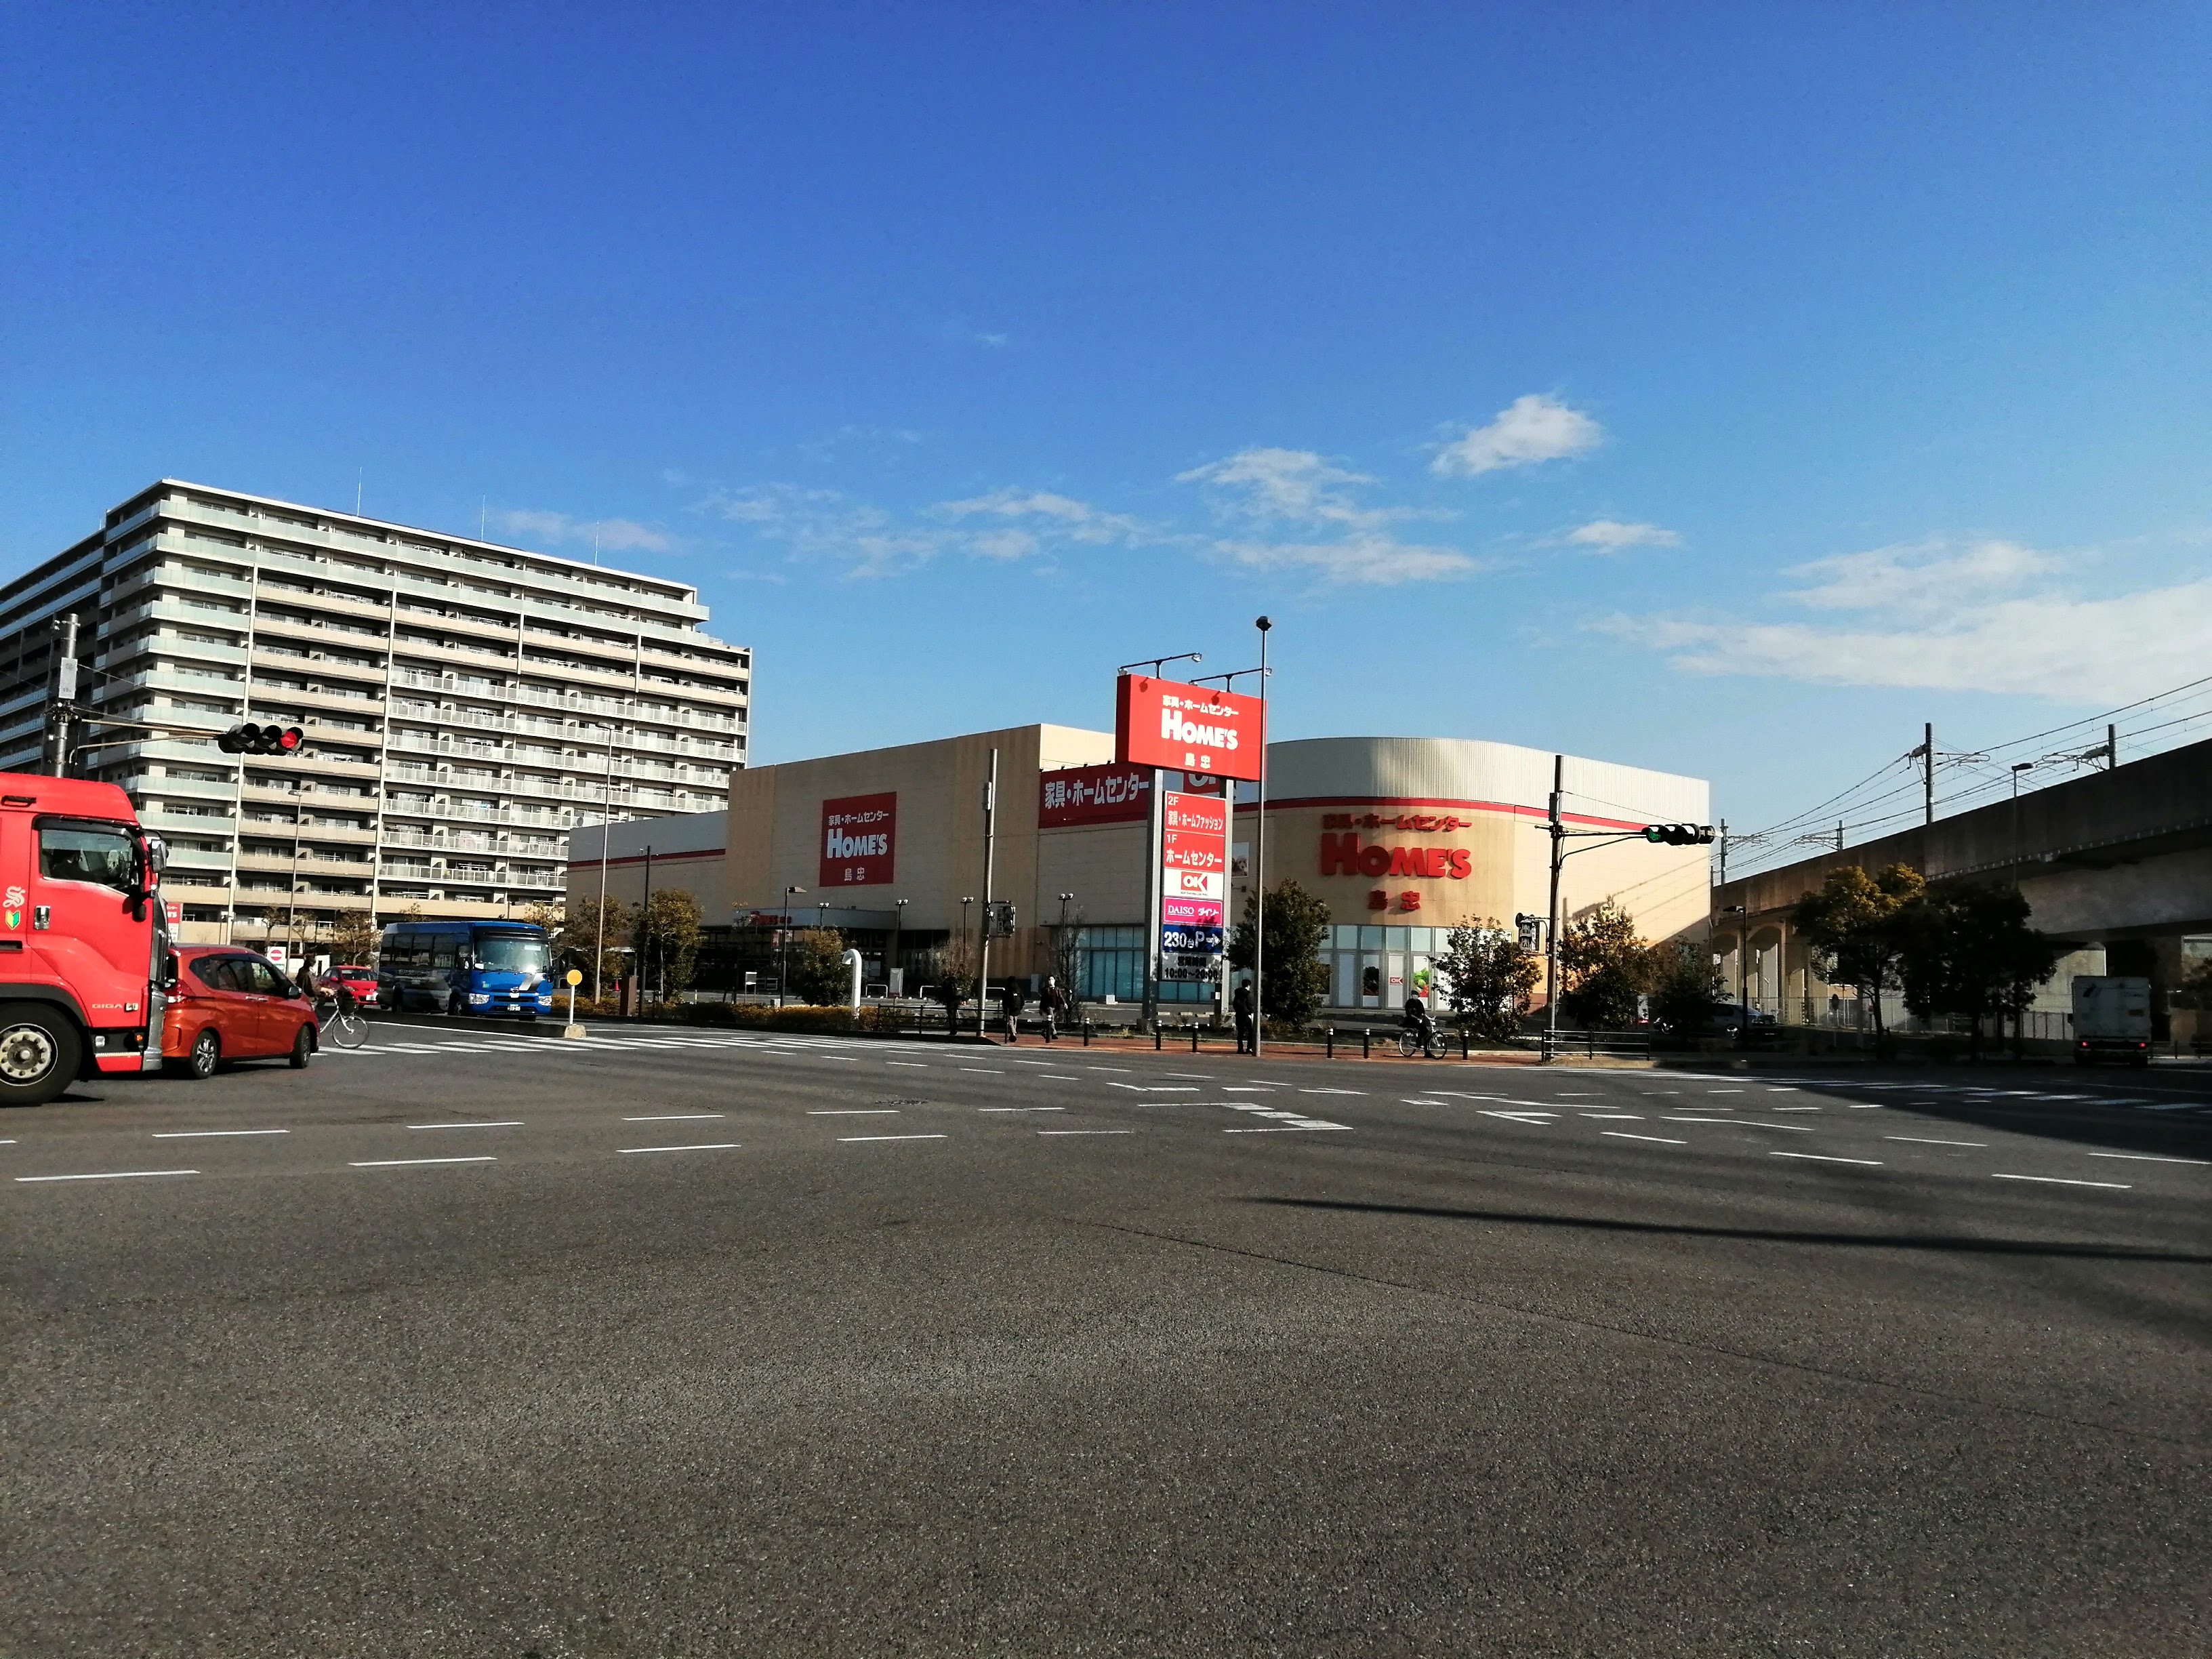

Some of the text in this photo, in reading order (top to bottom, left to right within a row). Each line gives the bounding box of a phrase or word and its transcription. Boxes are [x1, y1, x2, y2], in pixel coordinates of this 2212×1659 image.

[1161, 708, 1239, 750] HOME'S
[1045, 773, 1149, 809] 家具・ホームセンター
[1168, 796, 1179, 806] 2F
[828, 810, 889, 826] 家具・ホームセンター
[827, 827, 888, 859] HOME'S
[1167, 834, 1177, 844] 1F
[1166, 848, 1223, 867] ホームセンター
[1321, 832, 1472, 879] HOME'S
[1183, 873, 1208, 892] OK
[1168, 905, 1195, 916] DAISO
[1391, 977, 1404, 985] OK
